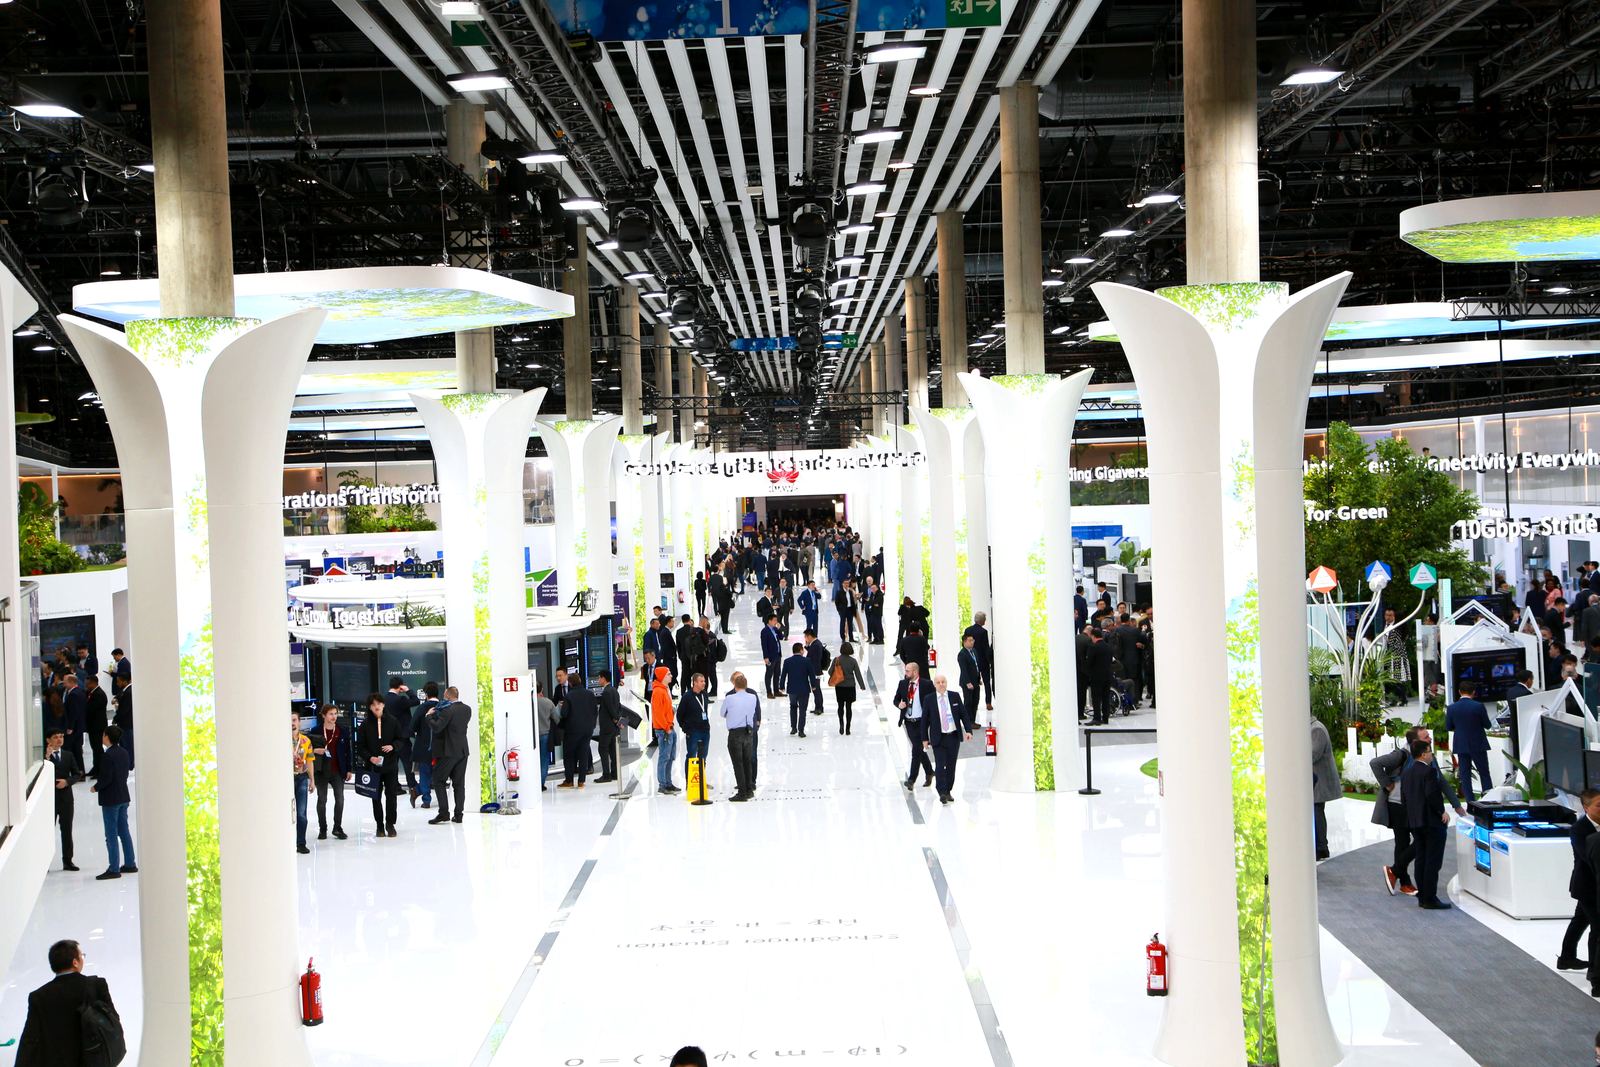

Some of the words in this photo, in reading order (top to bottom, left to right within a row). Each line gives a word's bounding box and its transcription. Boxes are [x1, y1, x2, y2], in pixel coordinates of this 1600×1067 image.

[1306, 508, 1332, 521] for
[1338, 506, 1388, 520] Green
[1541, 514, 1598, 537] Stride
